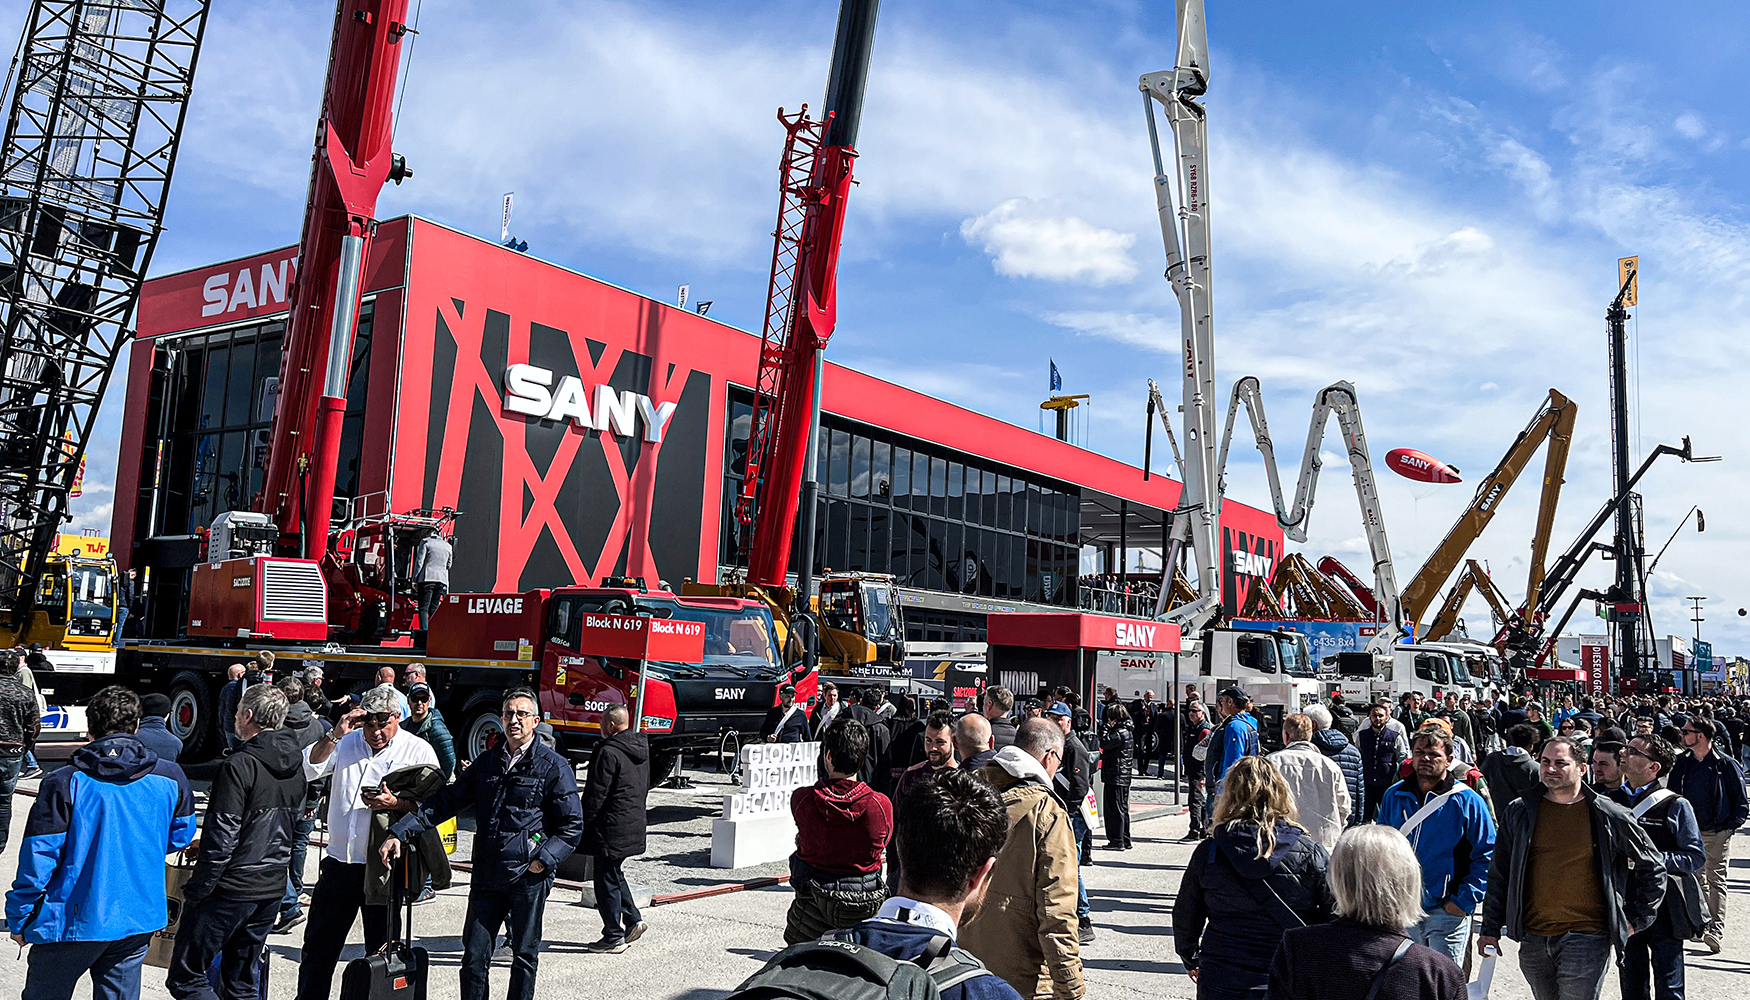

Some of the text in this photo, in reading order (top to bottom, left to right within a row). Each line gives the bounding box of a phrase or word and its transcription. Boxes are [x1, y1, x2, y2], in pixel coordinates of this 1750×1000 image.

[504, 363, 677, 443] SANY
[1400, 455, 1431, 470] SANY
[1480, 485, 1501, 511] SANY
[1233, 549, 1272, 578] SANY
[467, 598, 523, 614] LEVAGE
[586, 616, 643, 631] Block N 619
[652, 621, 701, 636] Block N 619
[1116, 622, 1156, 648] SANY
[1313, 638, 1336, 647] e435
[1338, 637, 1355, 647] 8x4
[1120, 658, 1156, 669] SANY
[1592, 647, 1602, 678] DIESEKO
[715, 688, 746, 700] SANY
[818, 941, 861, 954] osprey
